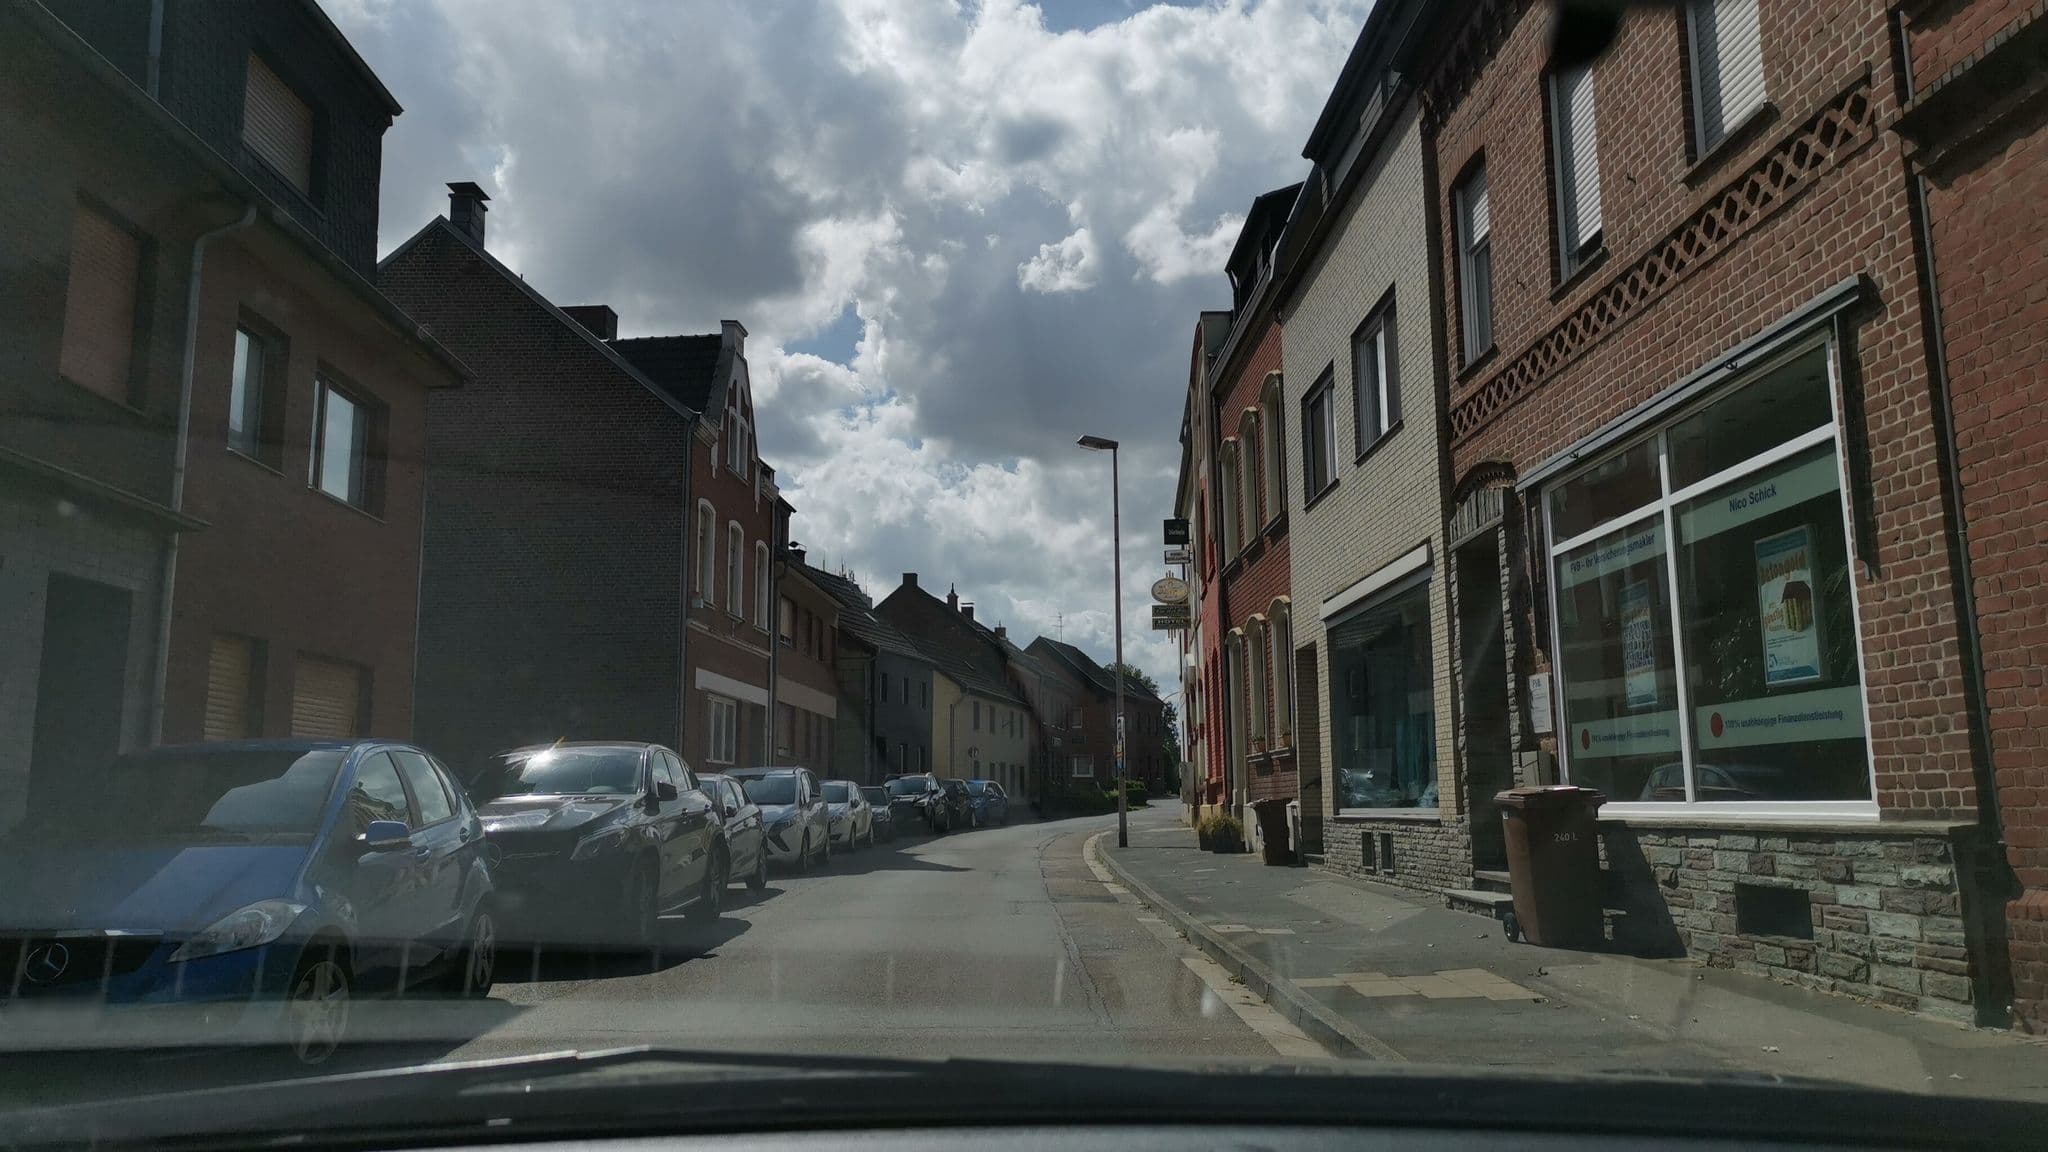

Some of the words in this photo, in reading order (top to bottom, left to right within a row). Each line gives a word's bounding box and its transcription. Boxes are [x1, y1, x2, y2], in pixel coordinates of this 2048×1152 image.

[1729, 497, 1747, 512] Nico
[1749, 483, 1777, 505] Schick
[1593, 534, 1655, 562] Versicherungsmakler
[1778, 710, 1843, 723] Finanzdienstleistung
[1572, 831, 1579, 841] L
